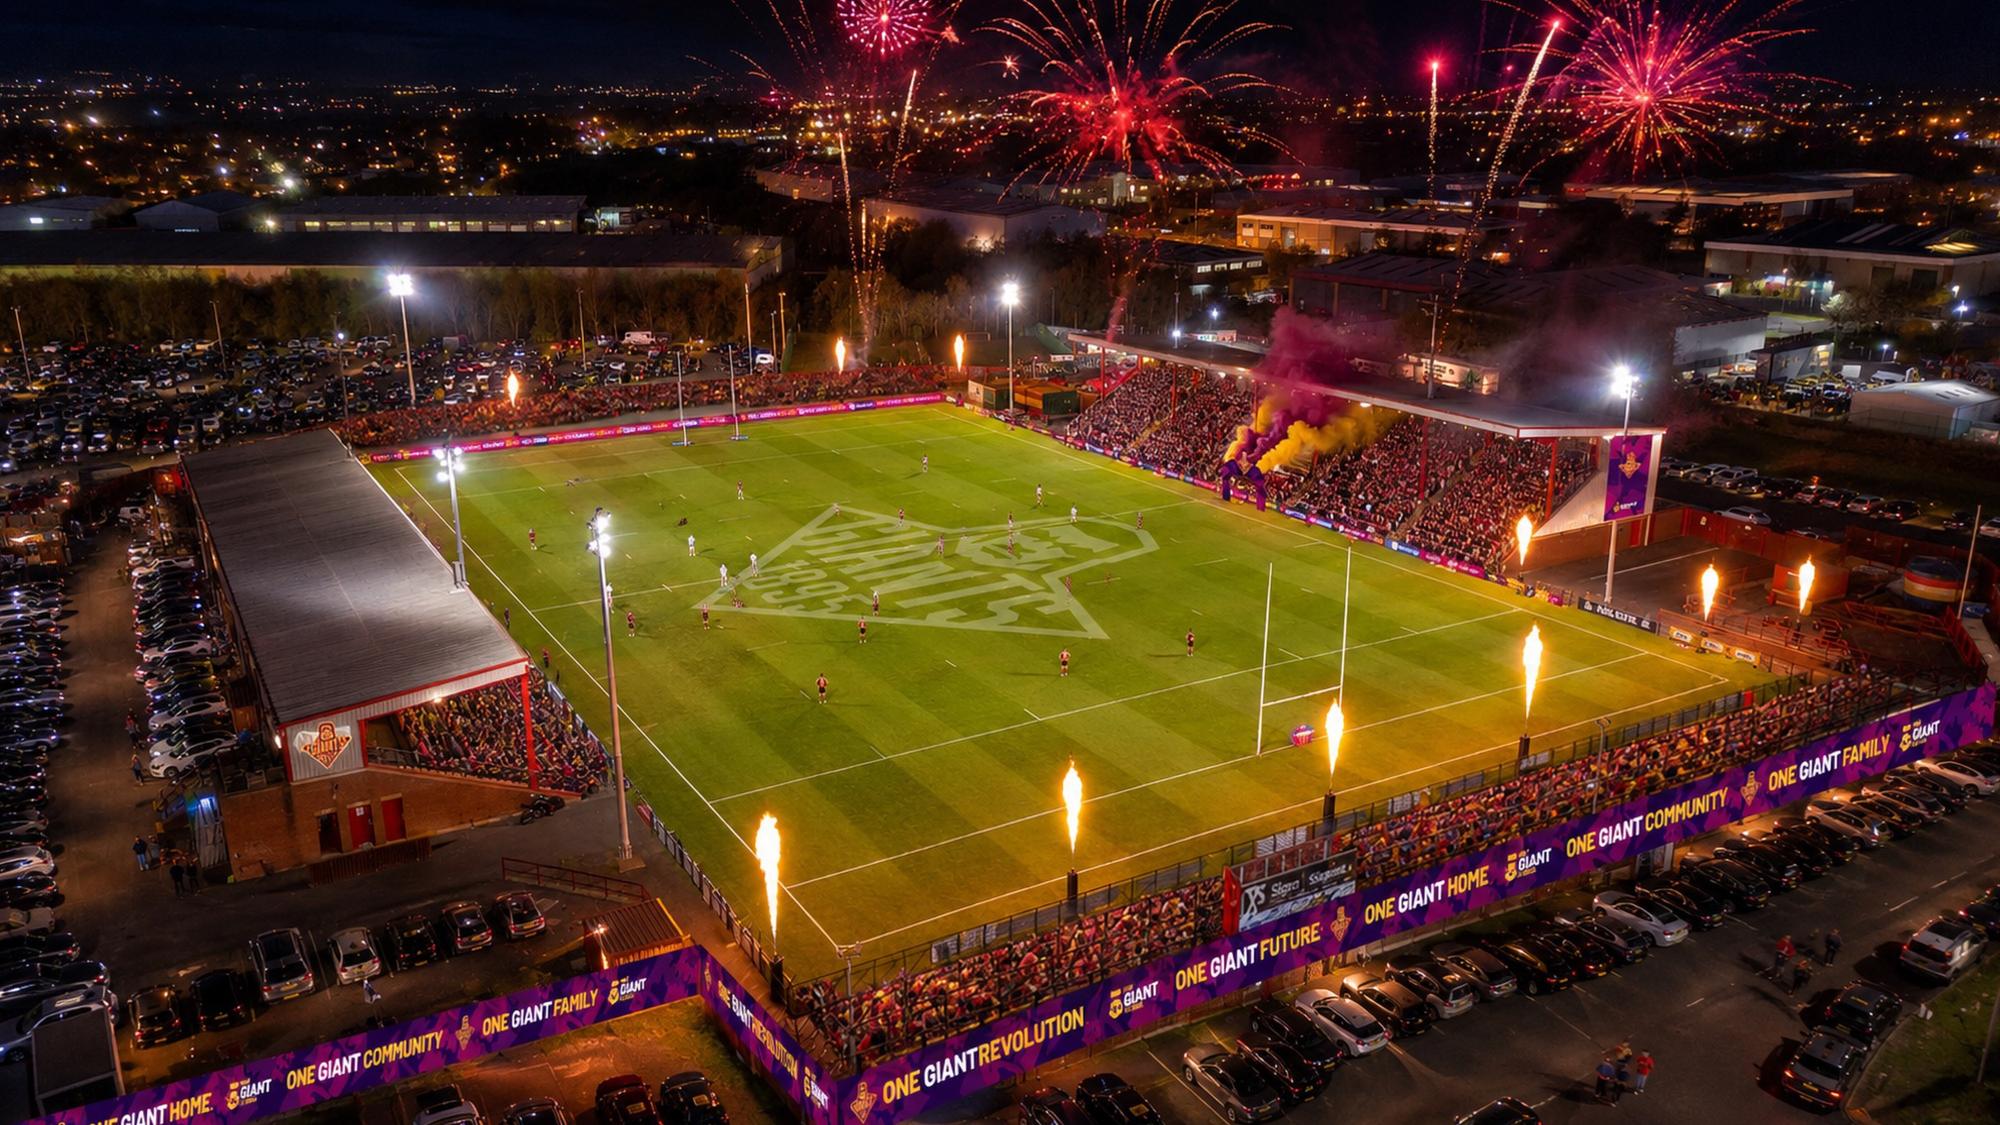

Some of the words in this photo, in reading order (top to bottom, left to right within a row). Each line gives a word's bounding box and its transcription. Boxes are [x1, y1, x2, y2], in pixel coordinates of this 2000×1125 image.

[1769, 765, 1797, 791] ONE
[1799, 750, 1841, 781] GIANT
[1842, 734, 1890, 767] FAMILY
[1566, 832, 1596, 858] ONE
[1598, 815, 1644, 847] GIANT
[1645, 787, 1729, 832] COMMUNITY
[1518, 848, 1552, 871] GIANT
[1365, 897, 1396, 925] ONE
[1398, 880, 1445, 913] GIANT
[1447, 865, 1489, 897] HOME
[1175, 961, 1207, 991] ONE
[1210, 943, 1258, 978] GIANT
[1260, 922, 1321, 960] FUTURE
[482, 1013, 509, 1036] ONE
[511, 1001, 553, 1028] GIANT
[553, 988, 599, 1016] FAMILY
[1123, 981, 1159, 1007] GIANT
[286, 1065, 316, 1090] ONE
[318, 1053, 361, 1082] GIANT
[363, 1030, 443, 1070] COMMUNITY
[882, 1069, 921, 1104] ONE
[923, 1047, 978, 1087] GIANT
[978, 1006, 1085, 1067] REVOLUTION
[121, 1104, 168, 1125] GIANT
[241, 1079, 272, 1099] GIANT
